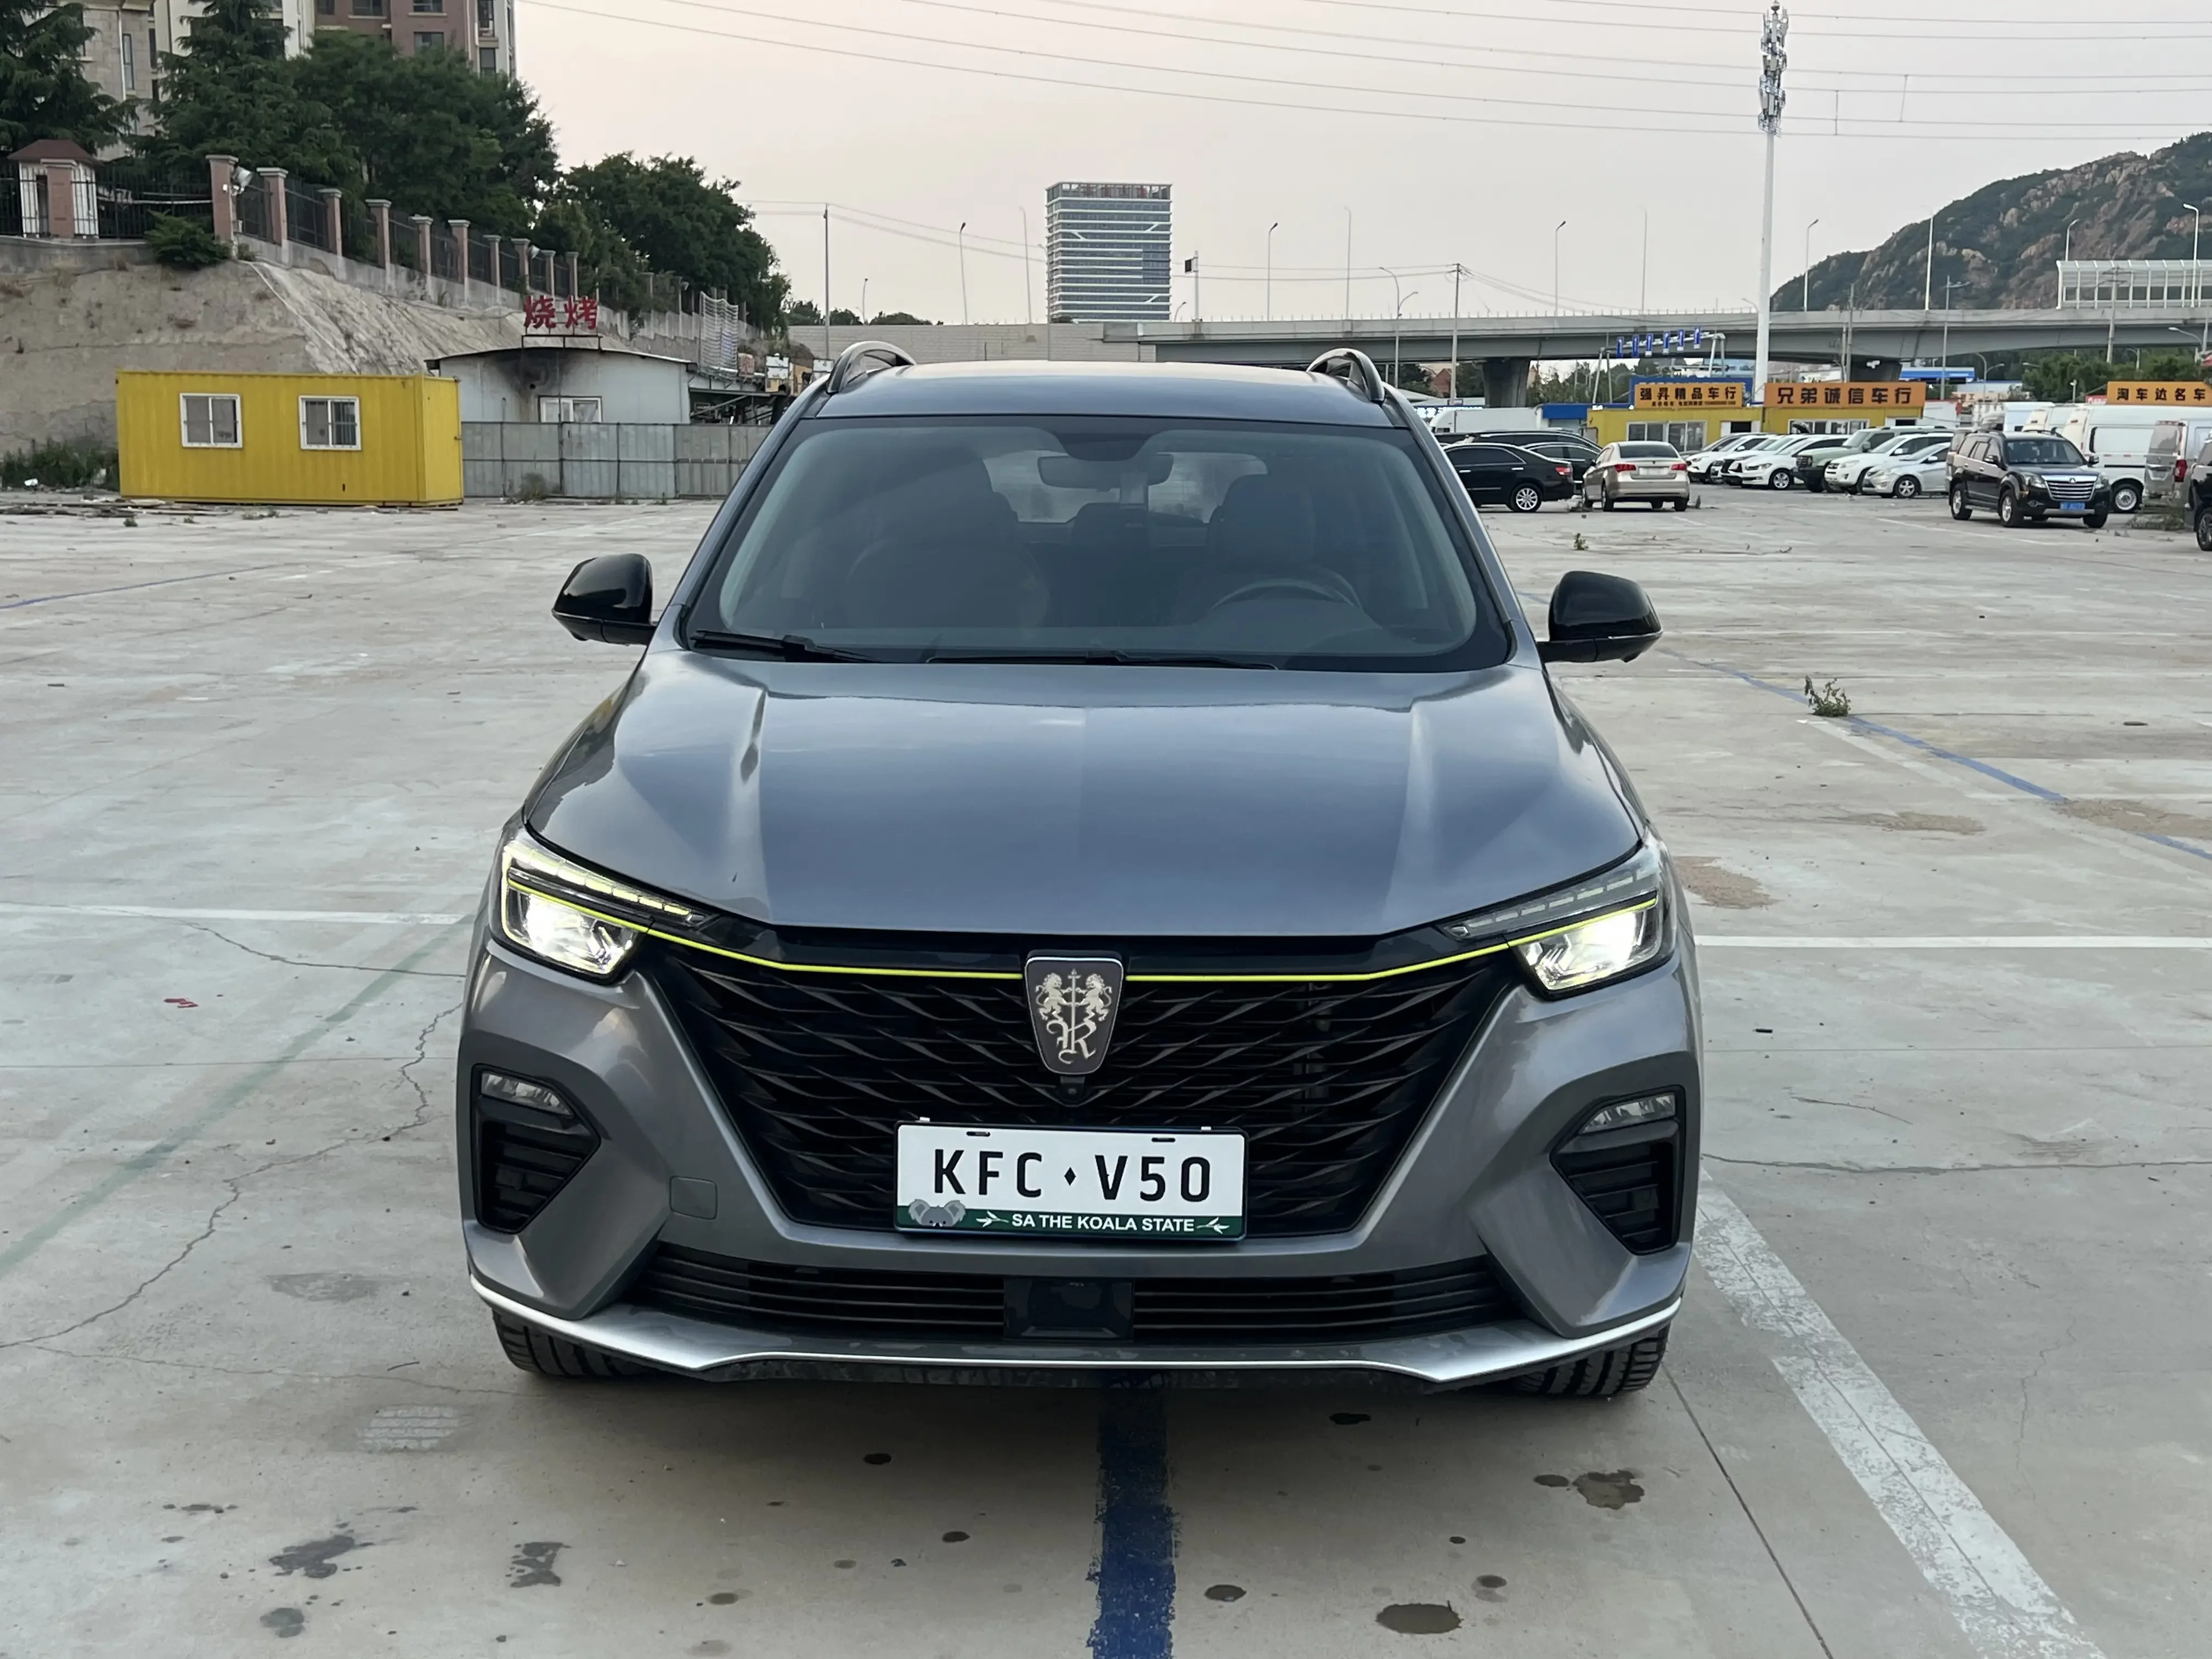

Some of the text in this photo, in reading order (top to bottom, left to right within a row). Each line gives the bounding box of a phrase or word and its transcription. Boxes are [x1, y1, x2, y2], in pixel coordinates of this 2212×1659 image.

[523, 295, 597, 330] 烧烤
[1778, 387, 1911, 404] 兄弟诚信车行
[934, 1149, 1211, 1202] KFC V50
[1012, 1214, 1195, 1232] SA THE KOALA STATE
